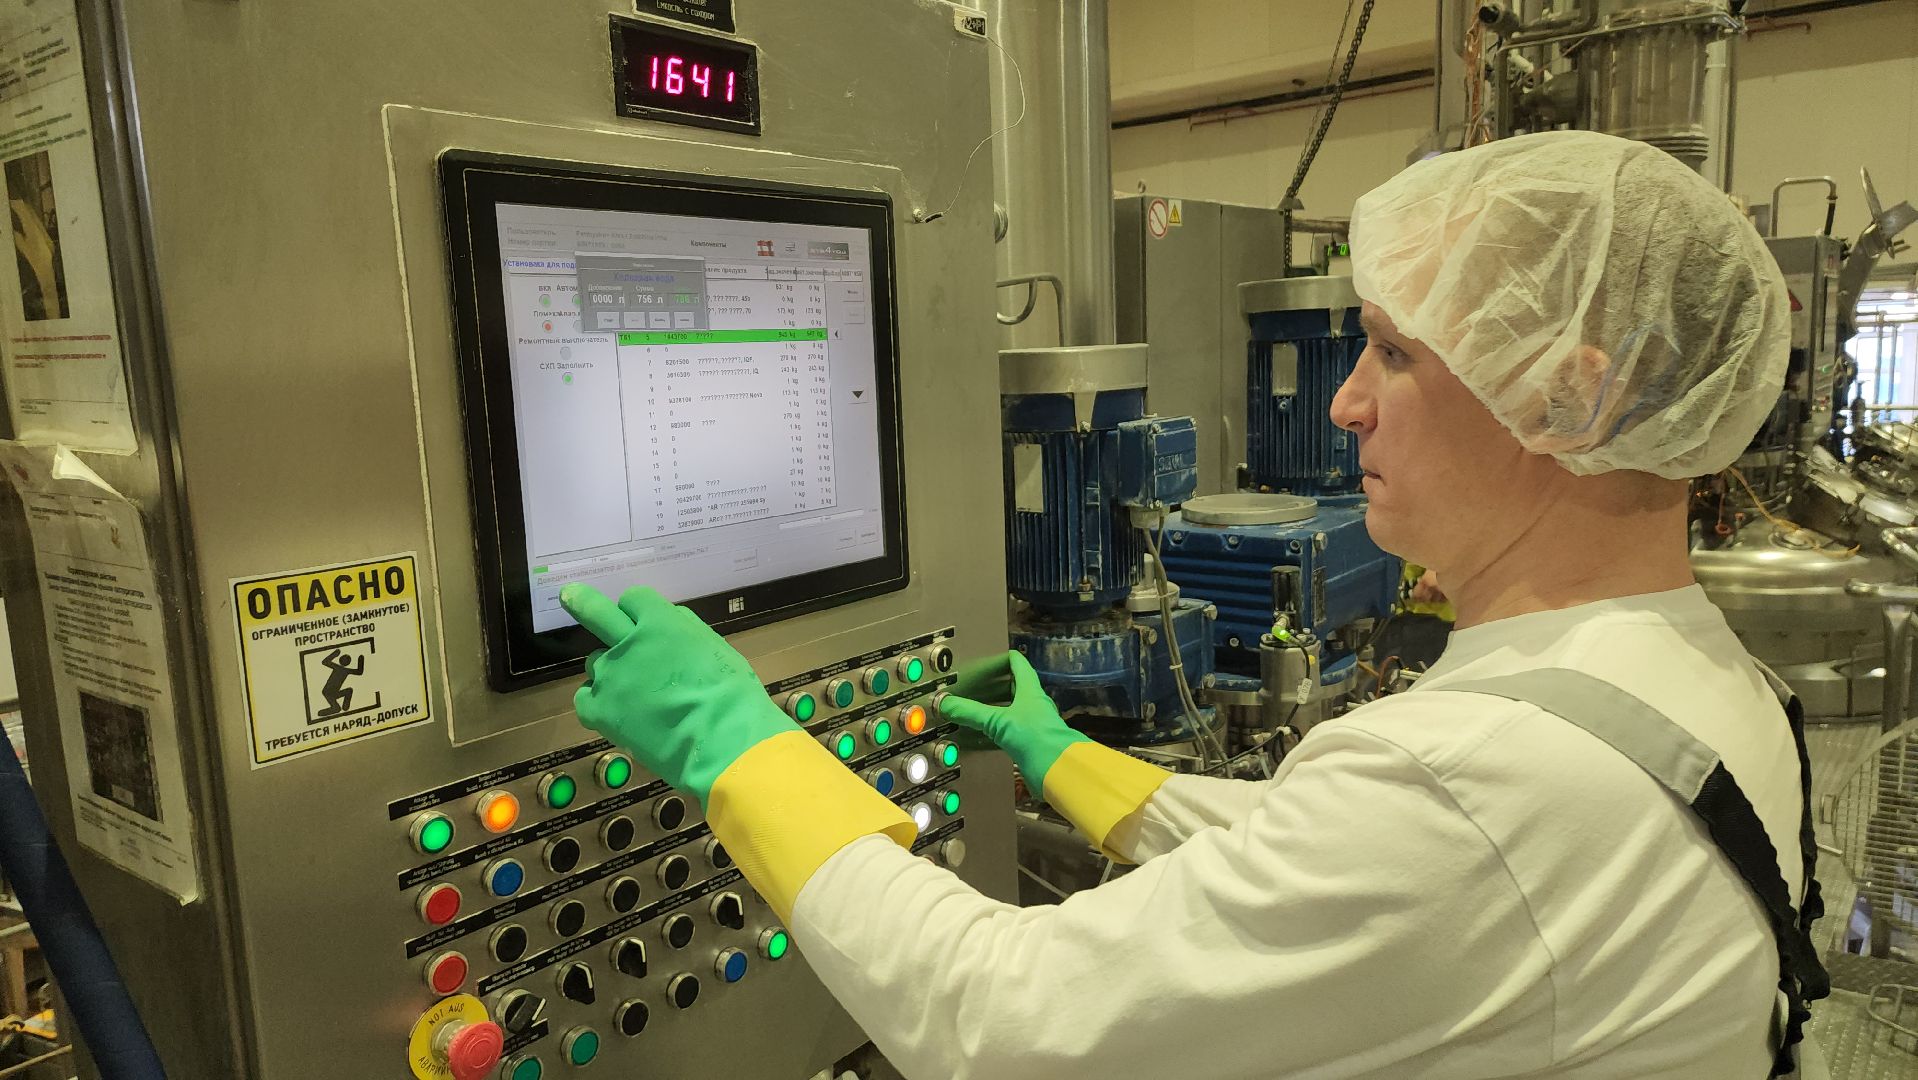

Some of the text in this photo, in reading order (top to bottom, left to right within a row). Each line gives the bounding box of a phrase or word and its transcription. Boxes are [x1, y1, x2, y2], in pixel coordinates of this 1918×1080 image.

[651, 57, 735, 102] 1641
[592, 294, 613, 304] 0000
[636, 294, 652, 304] 756
[247, 565, 405, 620] ОПАСНО
[252, 602, 410, 641] ОГРАНИЧЕННОЕ (ЗАМКНУТОЕ)
[294, 622, 376, 647] ПРОСТРАНСТВО
[265, 703, 419, 752] ТРЕБУЕТСЯ НАРЯД-ДОПУСК
[428, 1010, 444, 1026] NOT
